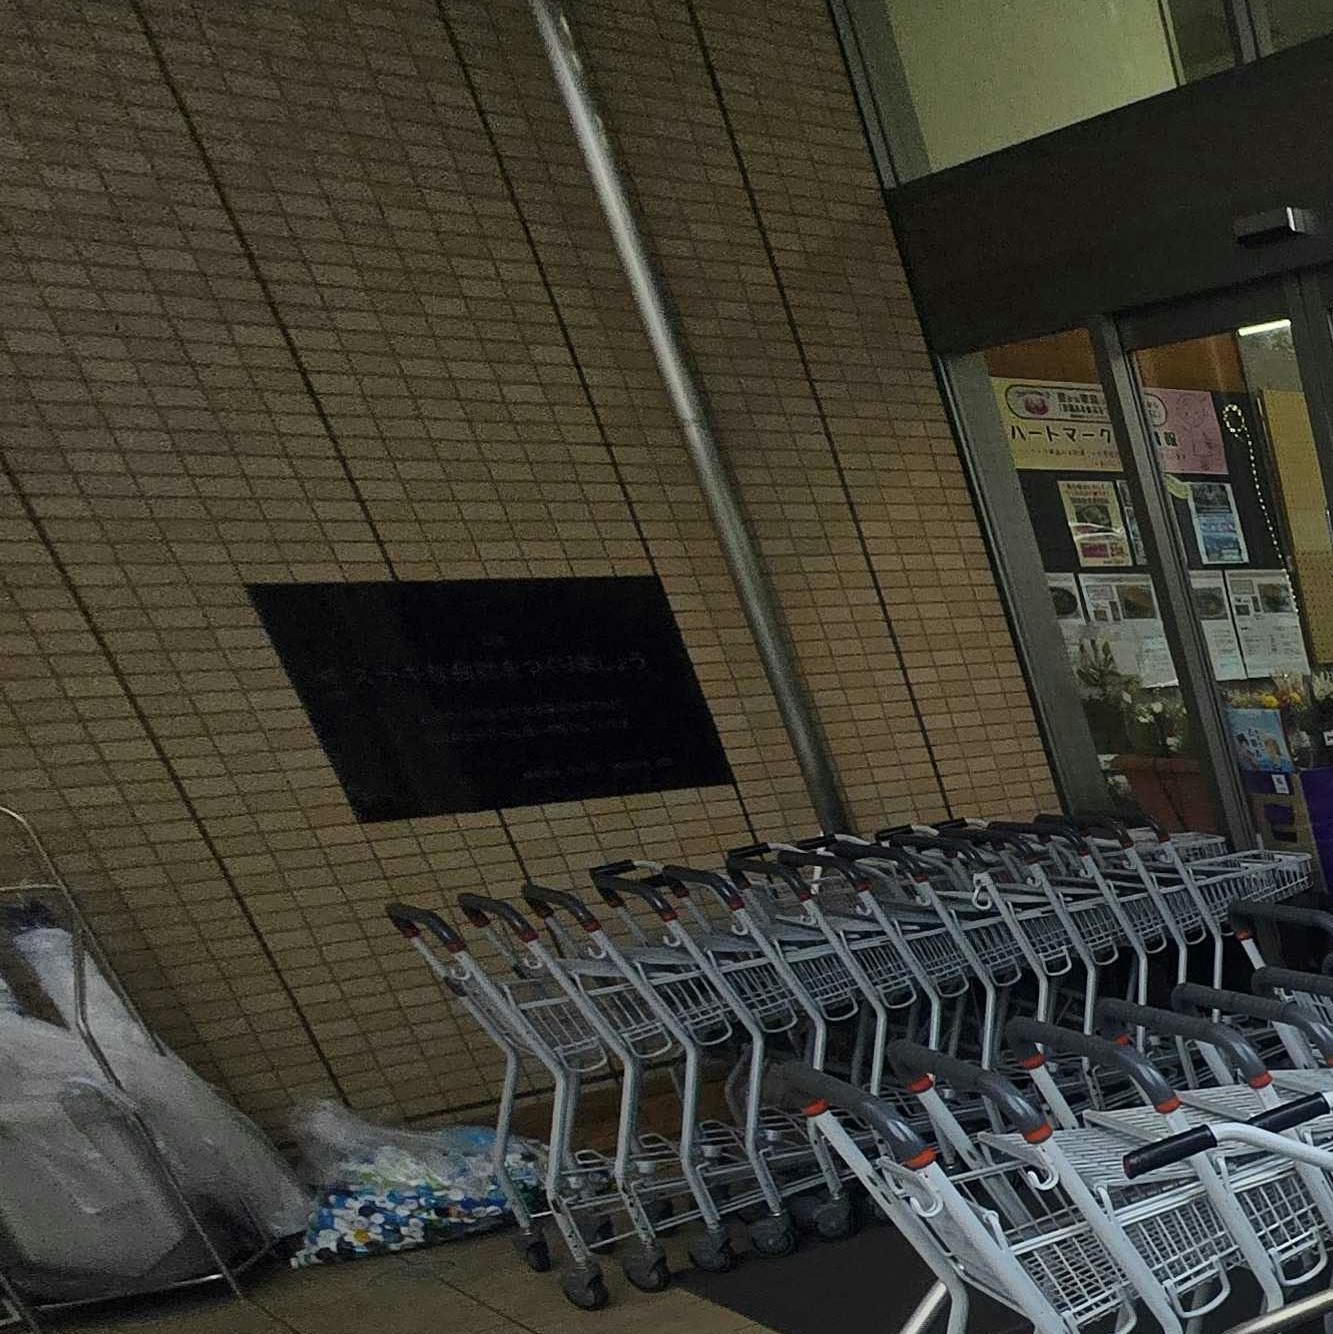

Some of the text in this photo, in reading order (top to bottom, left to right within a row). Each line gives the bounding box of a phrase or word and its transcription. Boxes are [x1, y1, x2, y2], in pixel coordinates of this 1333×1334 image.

[1010, 425, 1111, 444] ハートマーク
